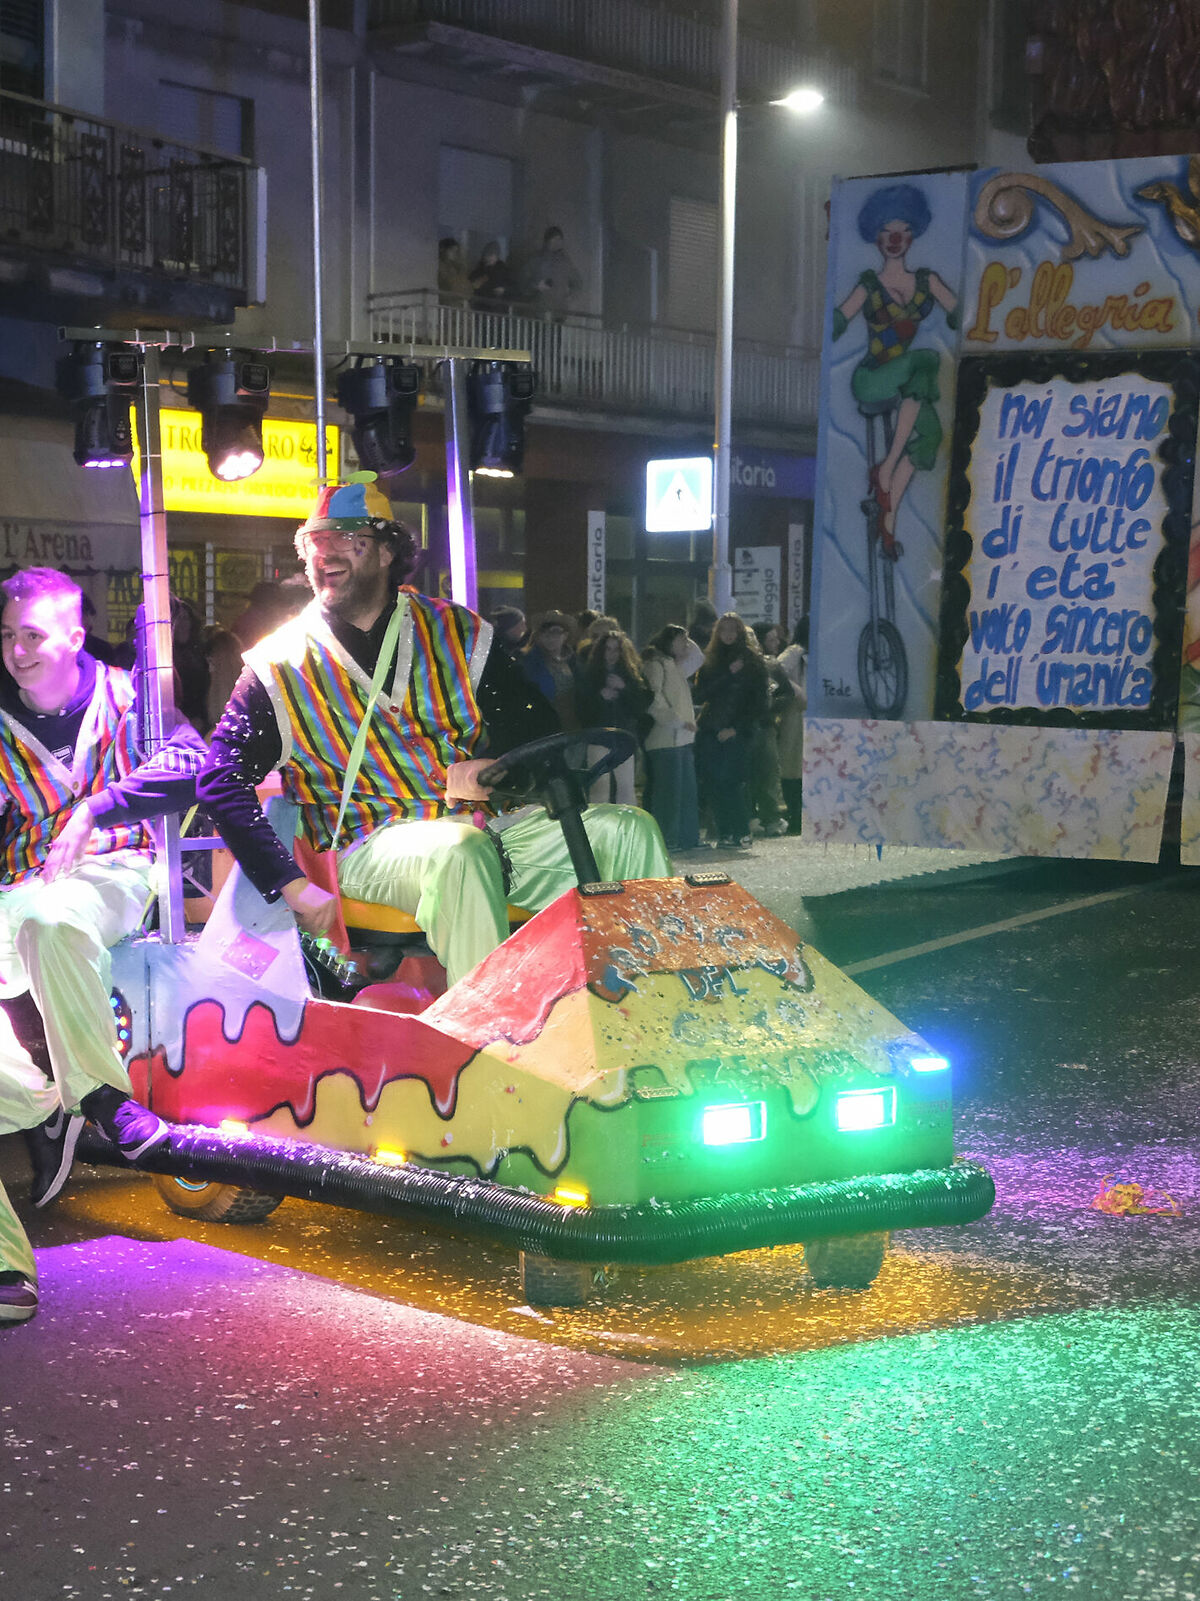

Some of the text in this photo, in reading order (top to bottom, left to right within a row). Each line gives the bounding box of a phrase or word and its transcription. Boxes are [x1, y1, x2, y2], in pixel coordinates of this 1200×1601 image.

[999, 388, 1171, 441] noi siamo
[992, 438, 1156, 511] il trionfo
[981, 503, 1153, 559] di tutte
[1040, 601, 1153, 656] sincero
[822, 677, 851, 697] Fede
